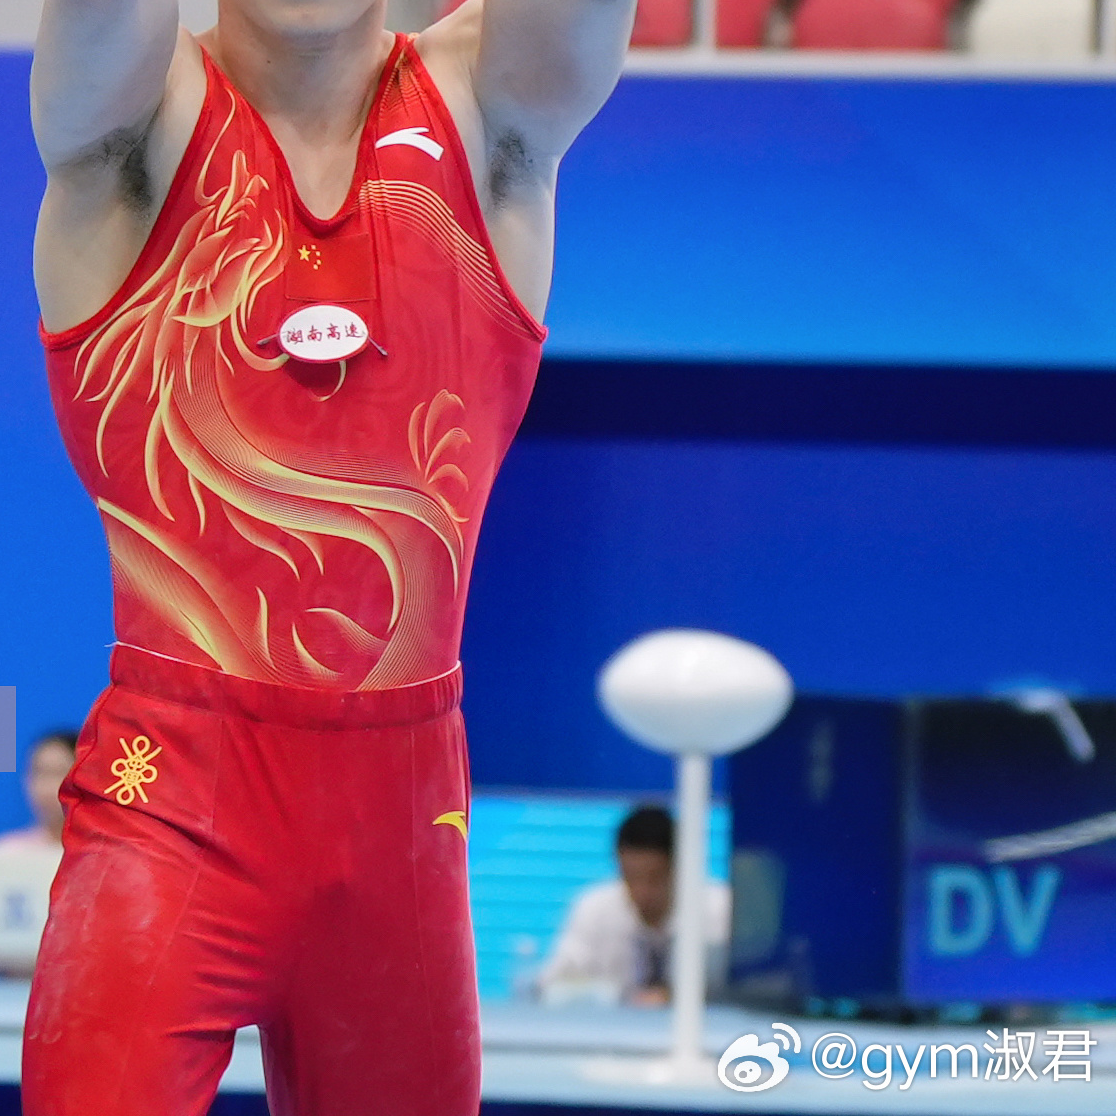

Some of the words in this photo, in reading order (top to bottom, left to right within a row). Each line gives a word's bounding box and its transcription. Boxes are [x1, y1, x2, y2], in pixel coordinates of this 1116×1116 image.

[284, 322, 364, 345] 湖南高速
[929, 864, 1061, 955] DV
